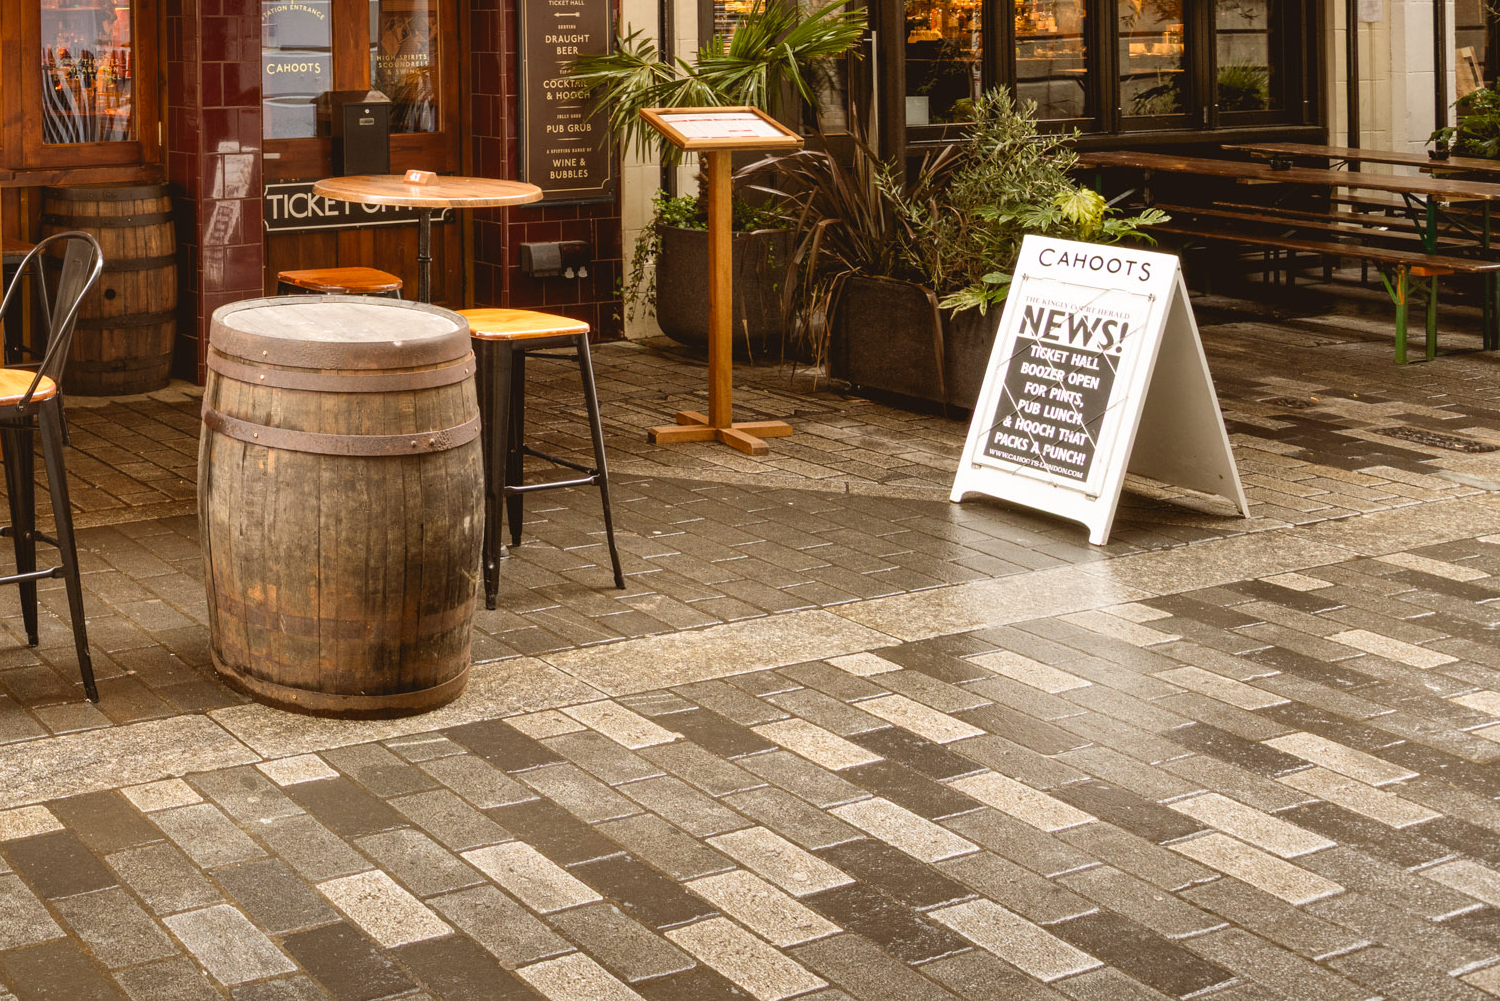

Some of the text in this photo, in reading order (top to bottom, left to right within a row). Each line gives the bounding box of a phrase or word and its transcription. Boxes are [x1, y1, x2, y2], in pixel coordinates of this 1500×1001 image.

[289, 4, 325, 21] ENTRANCE
[545, 34, 590, 44] DRAUGHT
[556, 46, 579, 55] BEER
[266, 62, 321, 75] CAHOOTS
[378, 61, 429, 69] SCOUNDRELS
[546, 91, 591, 101] & HOOCH
[546, 123, 592, 134] PUB GRUB
[552, 157, 586, 168] WINE &
[550, 169, 588, 179] BUBBLES
[1039, 248, 1152, 282] CAHOOTS
[1041, 298, 1069, 309] KINGLY
[1097, 308, 1131, 320] HERALD
[1018, 304, 1130, 354] NEWS!
[1030, 345, 1100, 371] TICKET HALL
[1020, 361, 1101, 390] BOOZER OPEN
[1023, 381, 1085, 408] FOR PINTS,
[1018, 399, 1083, 425] PUB LUNCH
[1002, 415, 1089, 446] & HOOCH THAT
[993, 431, 1087, 466] PACKS A PUNCH!
